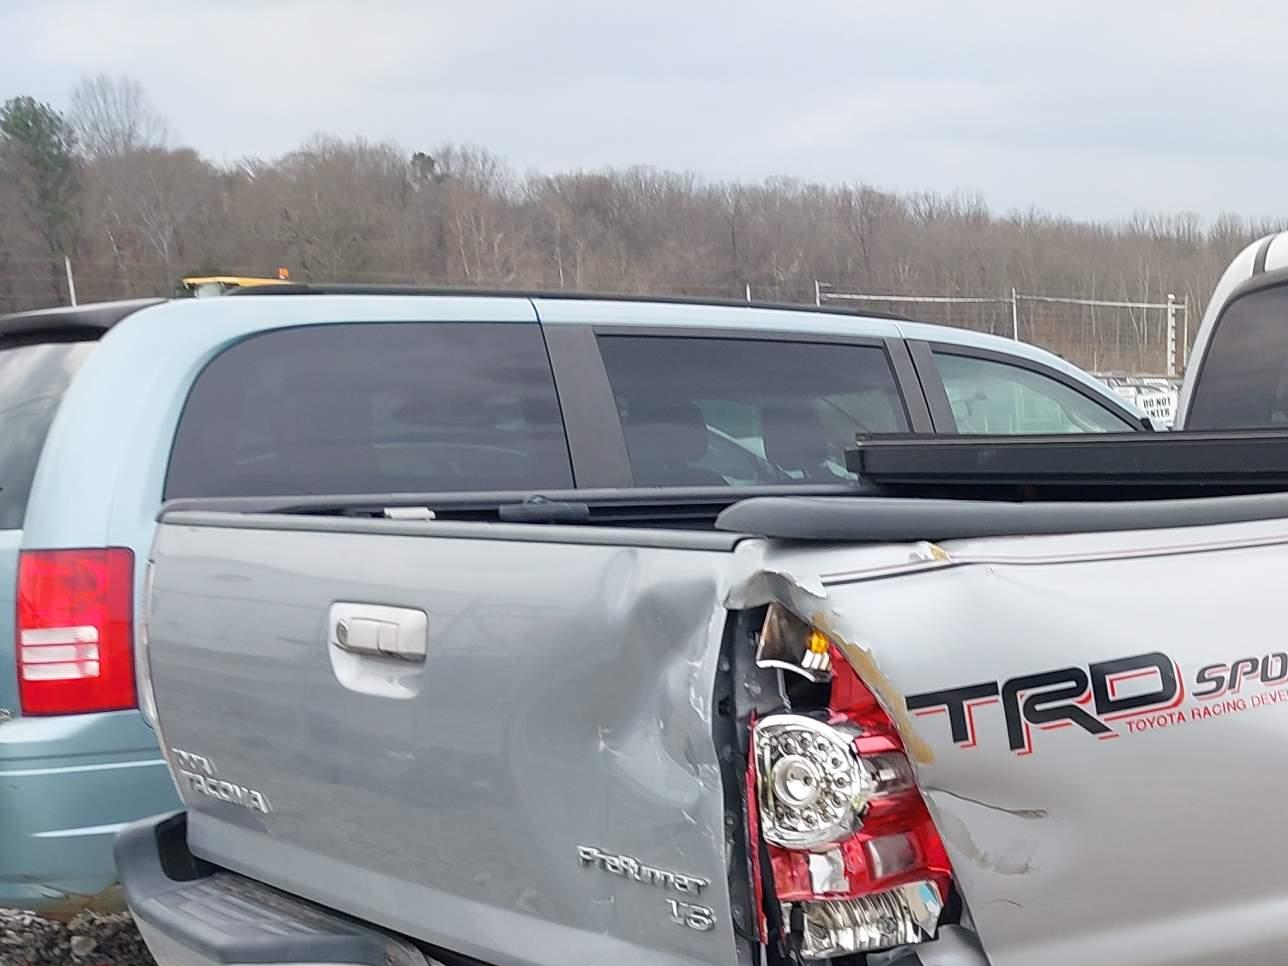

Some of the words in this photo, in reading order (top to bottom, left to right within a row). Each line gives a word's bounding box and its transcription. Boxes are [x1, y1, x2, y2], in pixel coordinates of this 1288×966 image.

[1143, 398, 1154, 409] DO
[1156, 397, 1171, 408] NOT
[1147, 408, 1170, 418] NTER
[904, 651, 1184, 756] TRD
[1126, 711, 1187, 734] TOYOTA
[1191, 698, 1247, 720] RACING
[179, 768, 272, 815] TACOMA
